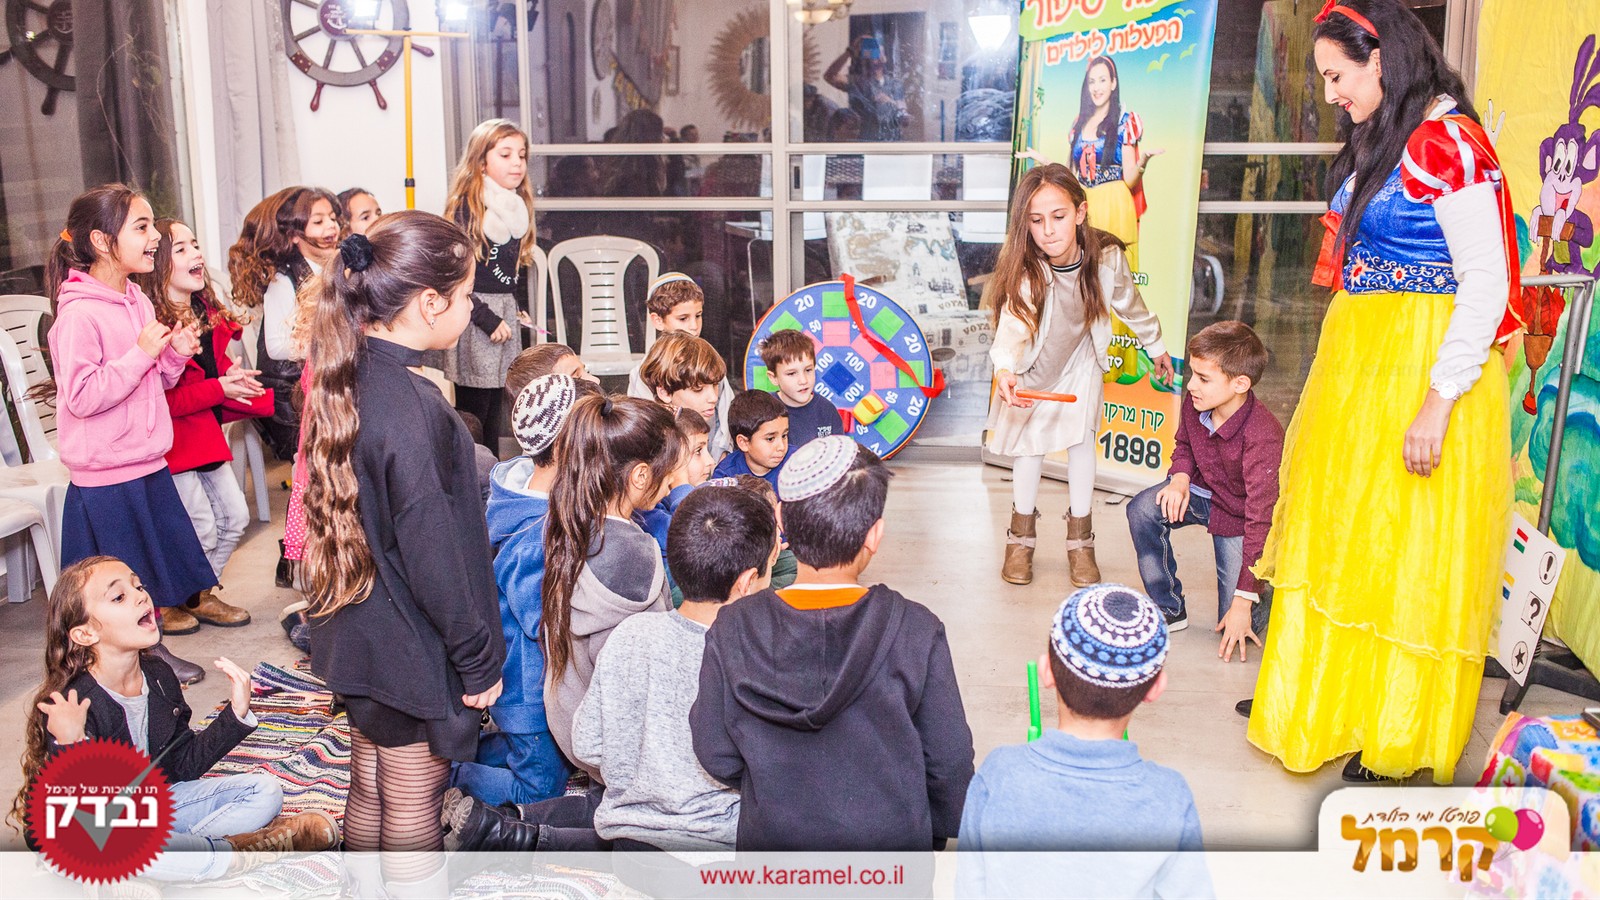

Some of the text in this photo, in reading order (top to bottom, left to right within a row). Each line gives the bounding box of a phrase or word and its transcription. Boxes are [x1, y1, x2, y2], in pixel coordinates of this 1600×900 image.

[1046, 19, 1181, 63] הפעלות לילדים
[794, 294, 815, 312] 20
[857, 292, 877, 309] 20
[808, 319, 822, 333] 50
[903, 333, 922, 353] 20
[814, 352, 834, 373] 100
[844, 351, 865, 372] 100
[844, 382, 865, 403] 100
[885, 390, 899, 404] 50
[906, 395, 924, 417] 20
[1103, 402, 1165, 432] קרן מרקו
[1099, 431, 1161, 470] 1898
